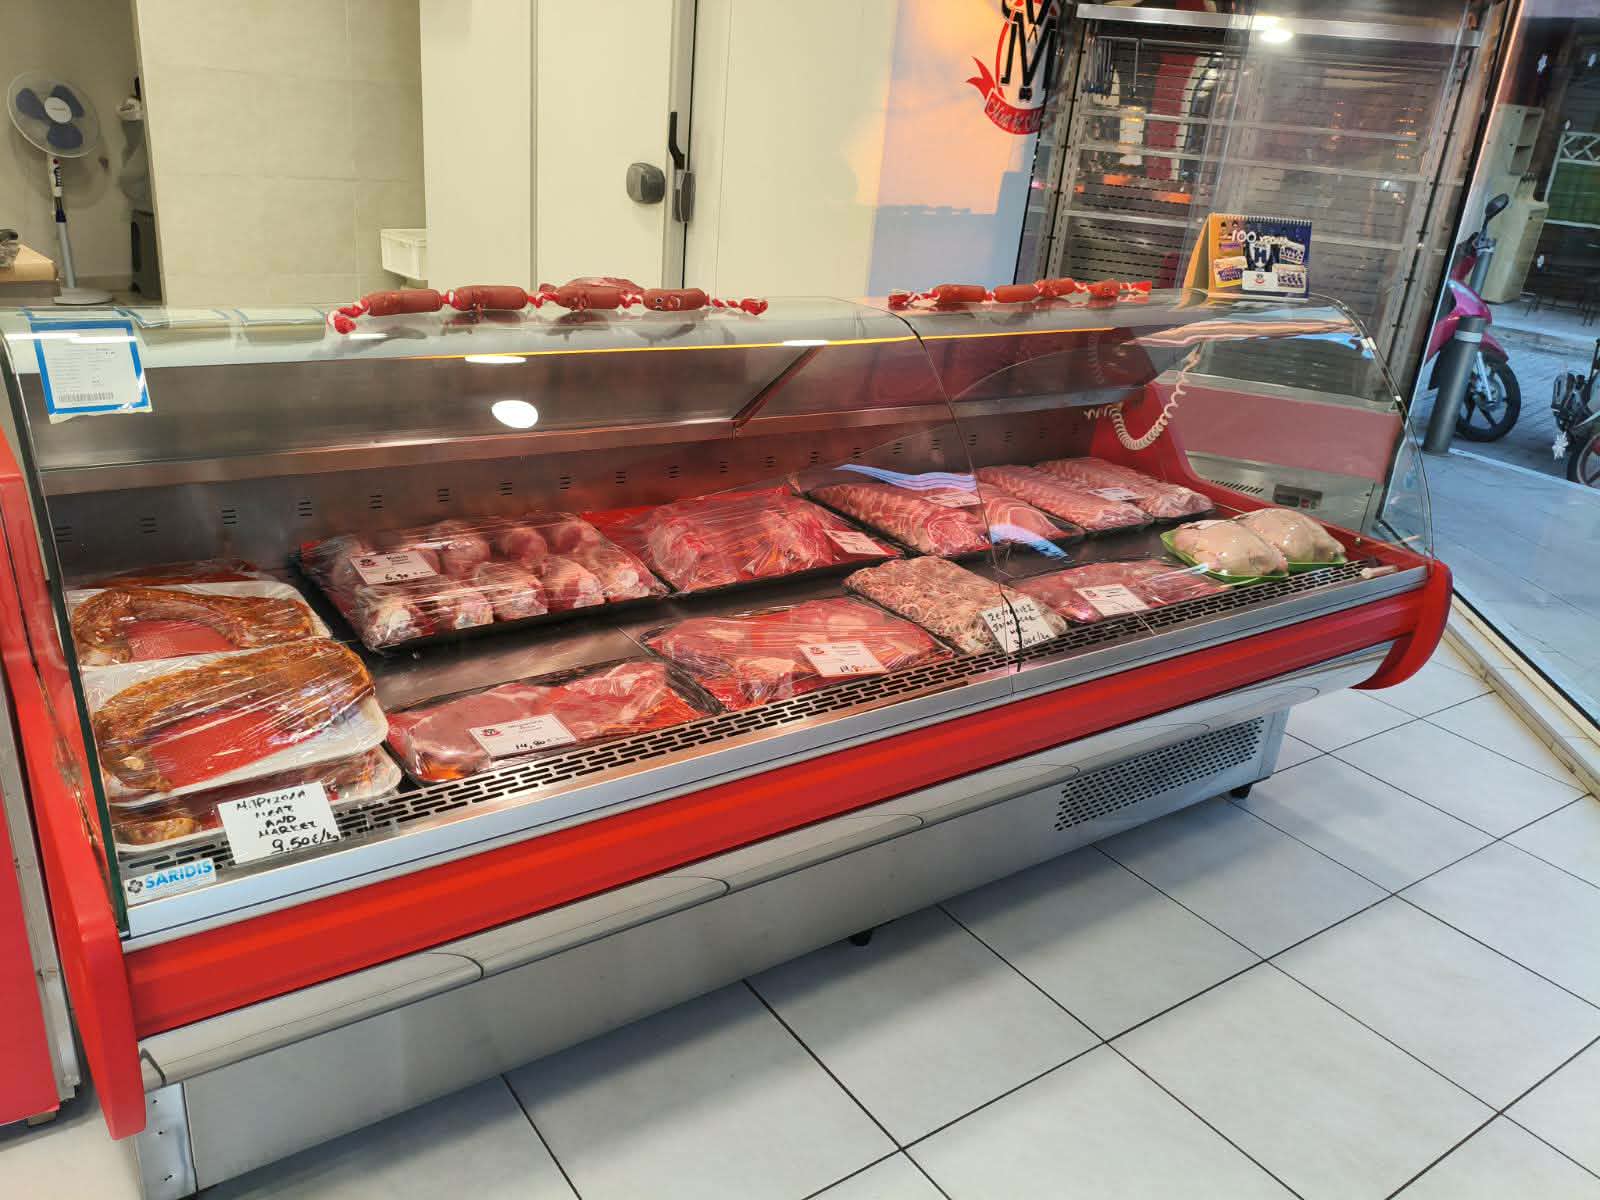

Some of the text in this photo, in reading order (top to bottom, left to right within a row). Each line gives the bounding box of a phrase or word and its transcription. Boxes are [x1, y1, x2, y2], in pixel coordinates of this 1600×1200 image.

[258, 821, 318, 838] MARKET
[265, 815, 297, 828] AND
[145, 859, 213, 890] SARIDIS
